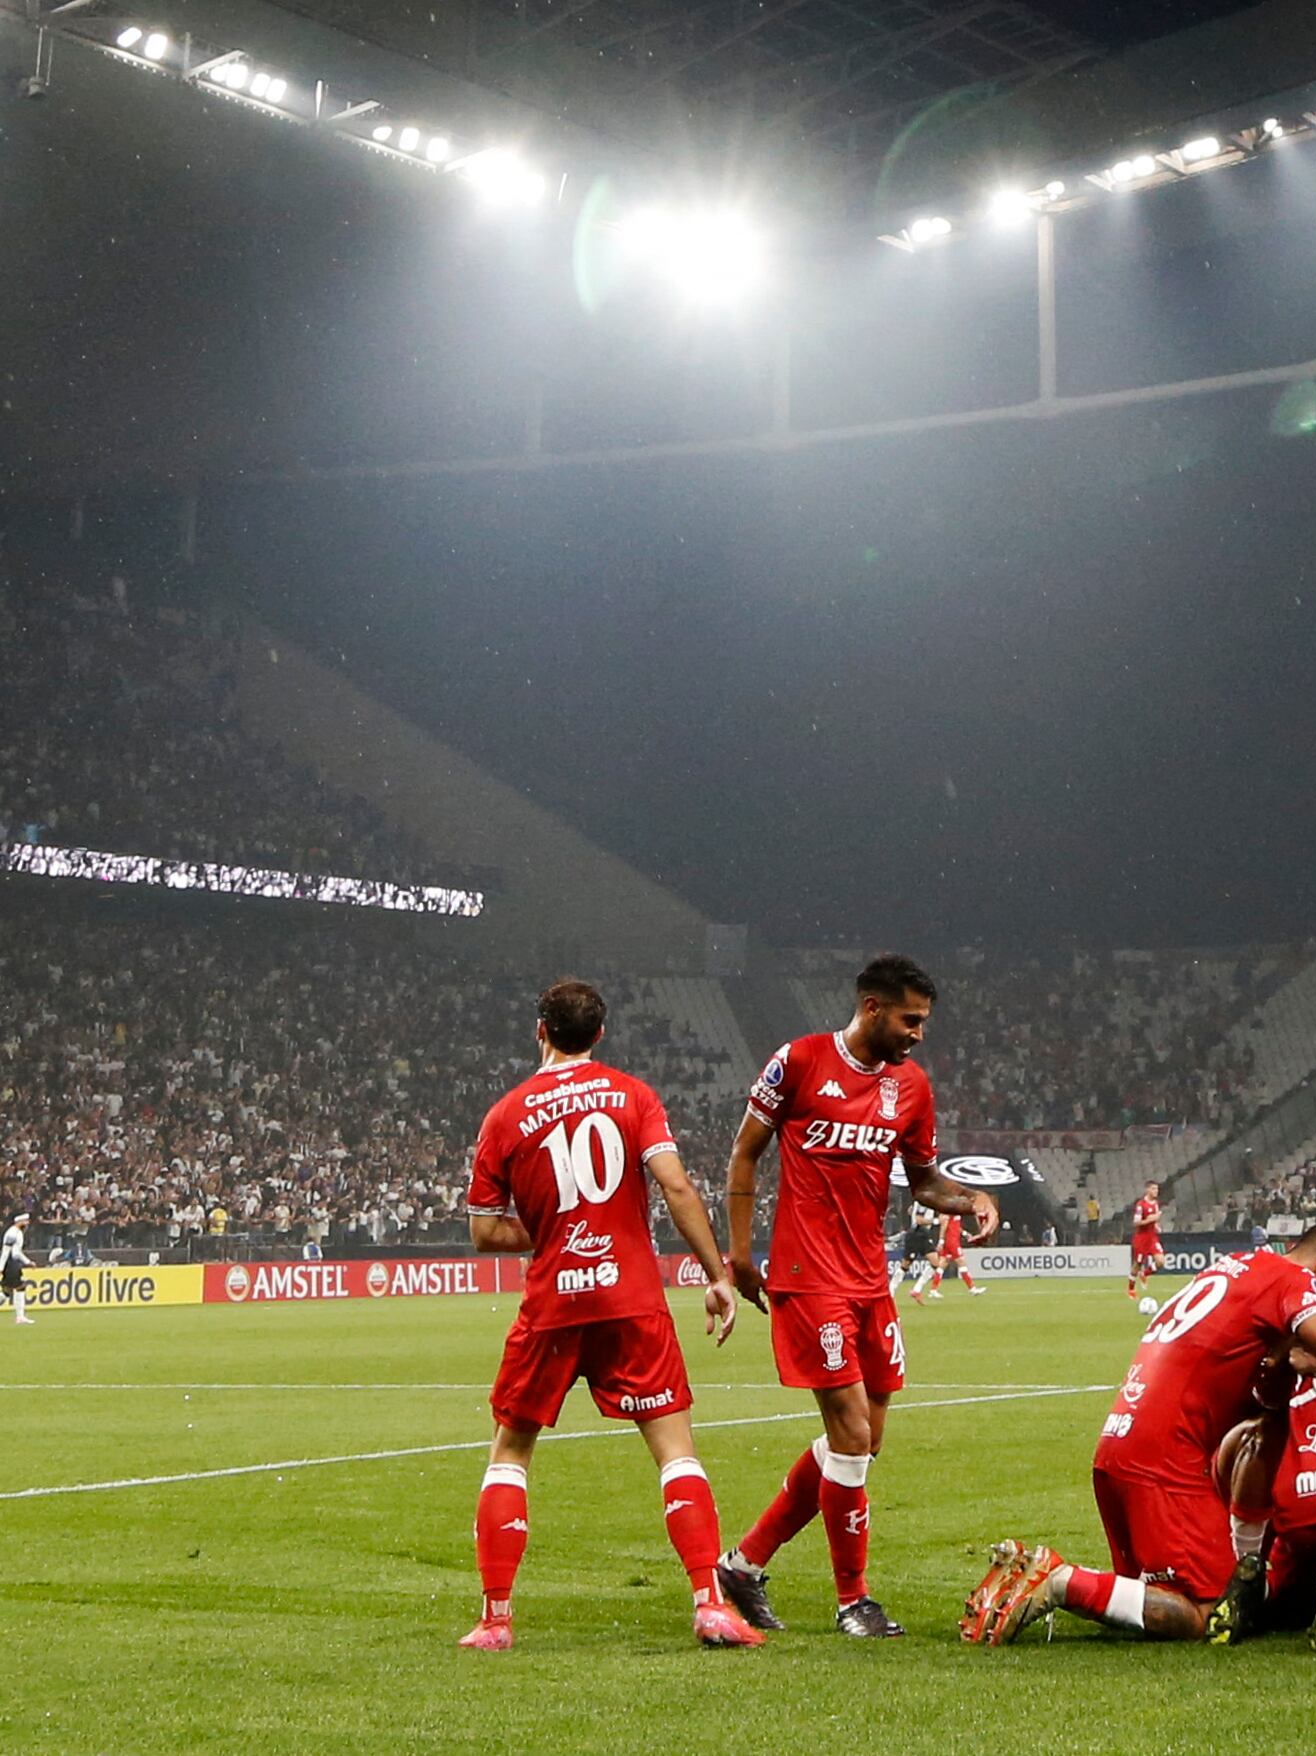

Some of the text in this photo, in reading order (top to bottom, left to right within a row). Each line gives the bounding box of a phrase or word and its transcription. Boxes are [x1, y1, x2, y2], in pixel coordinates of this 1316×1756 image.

[524, 1078, 611, 1108] Casablanca
[518, 1092, 627, 1138] MAZZANTTI
[539, 1111, 625, 1214] 10
[560, 1219, 614, 1258] Leiva
[98, 1270, 155, 1303] livre
[252, 1265, 349, 1299] AMSTEL
[391, 1262, 479, 1295] AMSTEL
